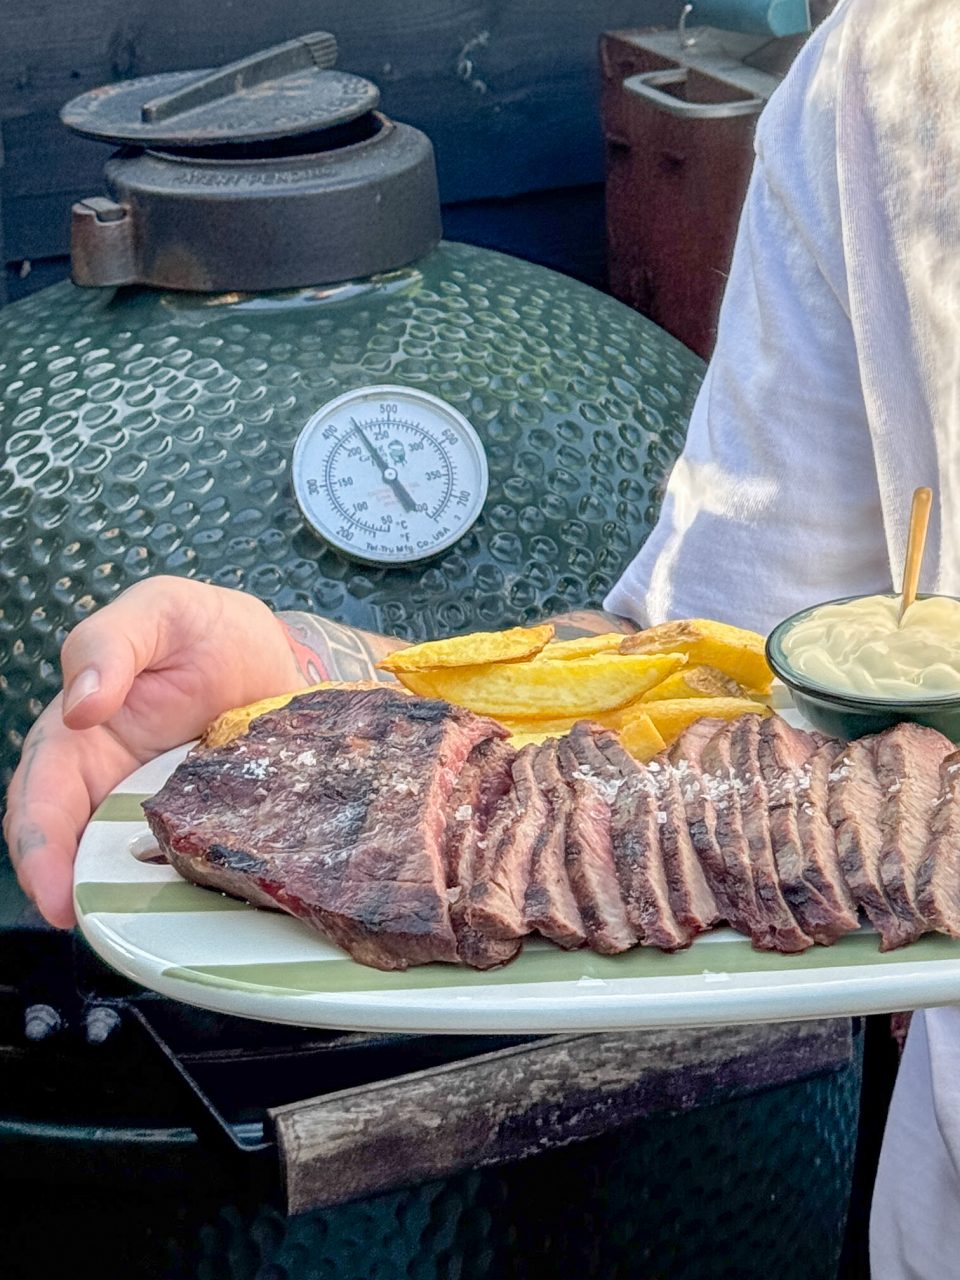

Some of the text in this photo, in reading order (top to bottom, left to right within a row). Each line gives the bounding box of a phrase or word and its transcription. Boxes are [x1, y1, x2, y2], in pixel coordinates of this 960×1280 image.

[380, 404, 398, 414] 500
[322, 424, 338, 440] 400
[373, 430, 390, 441] 250
[441, 428, 459, 446] 600
[347, 446, 362, 458] 200
[408, 440, 425, 452] 300
[425, 469, 441, 481] 350
[306, 479, 320, 495] 300
[337, 476, 354, 487] 150
[456, 490, 471, 507] 700
[352, 501, 369, 512] 100
[380, 514, 393, 525] 50
[336, 526, 354, 542] 200
[431, 526, 451, 541] USA
